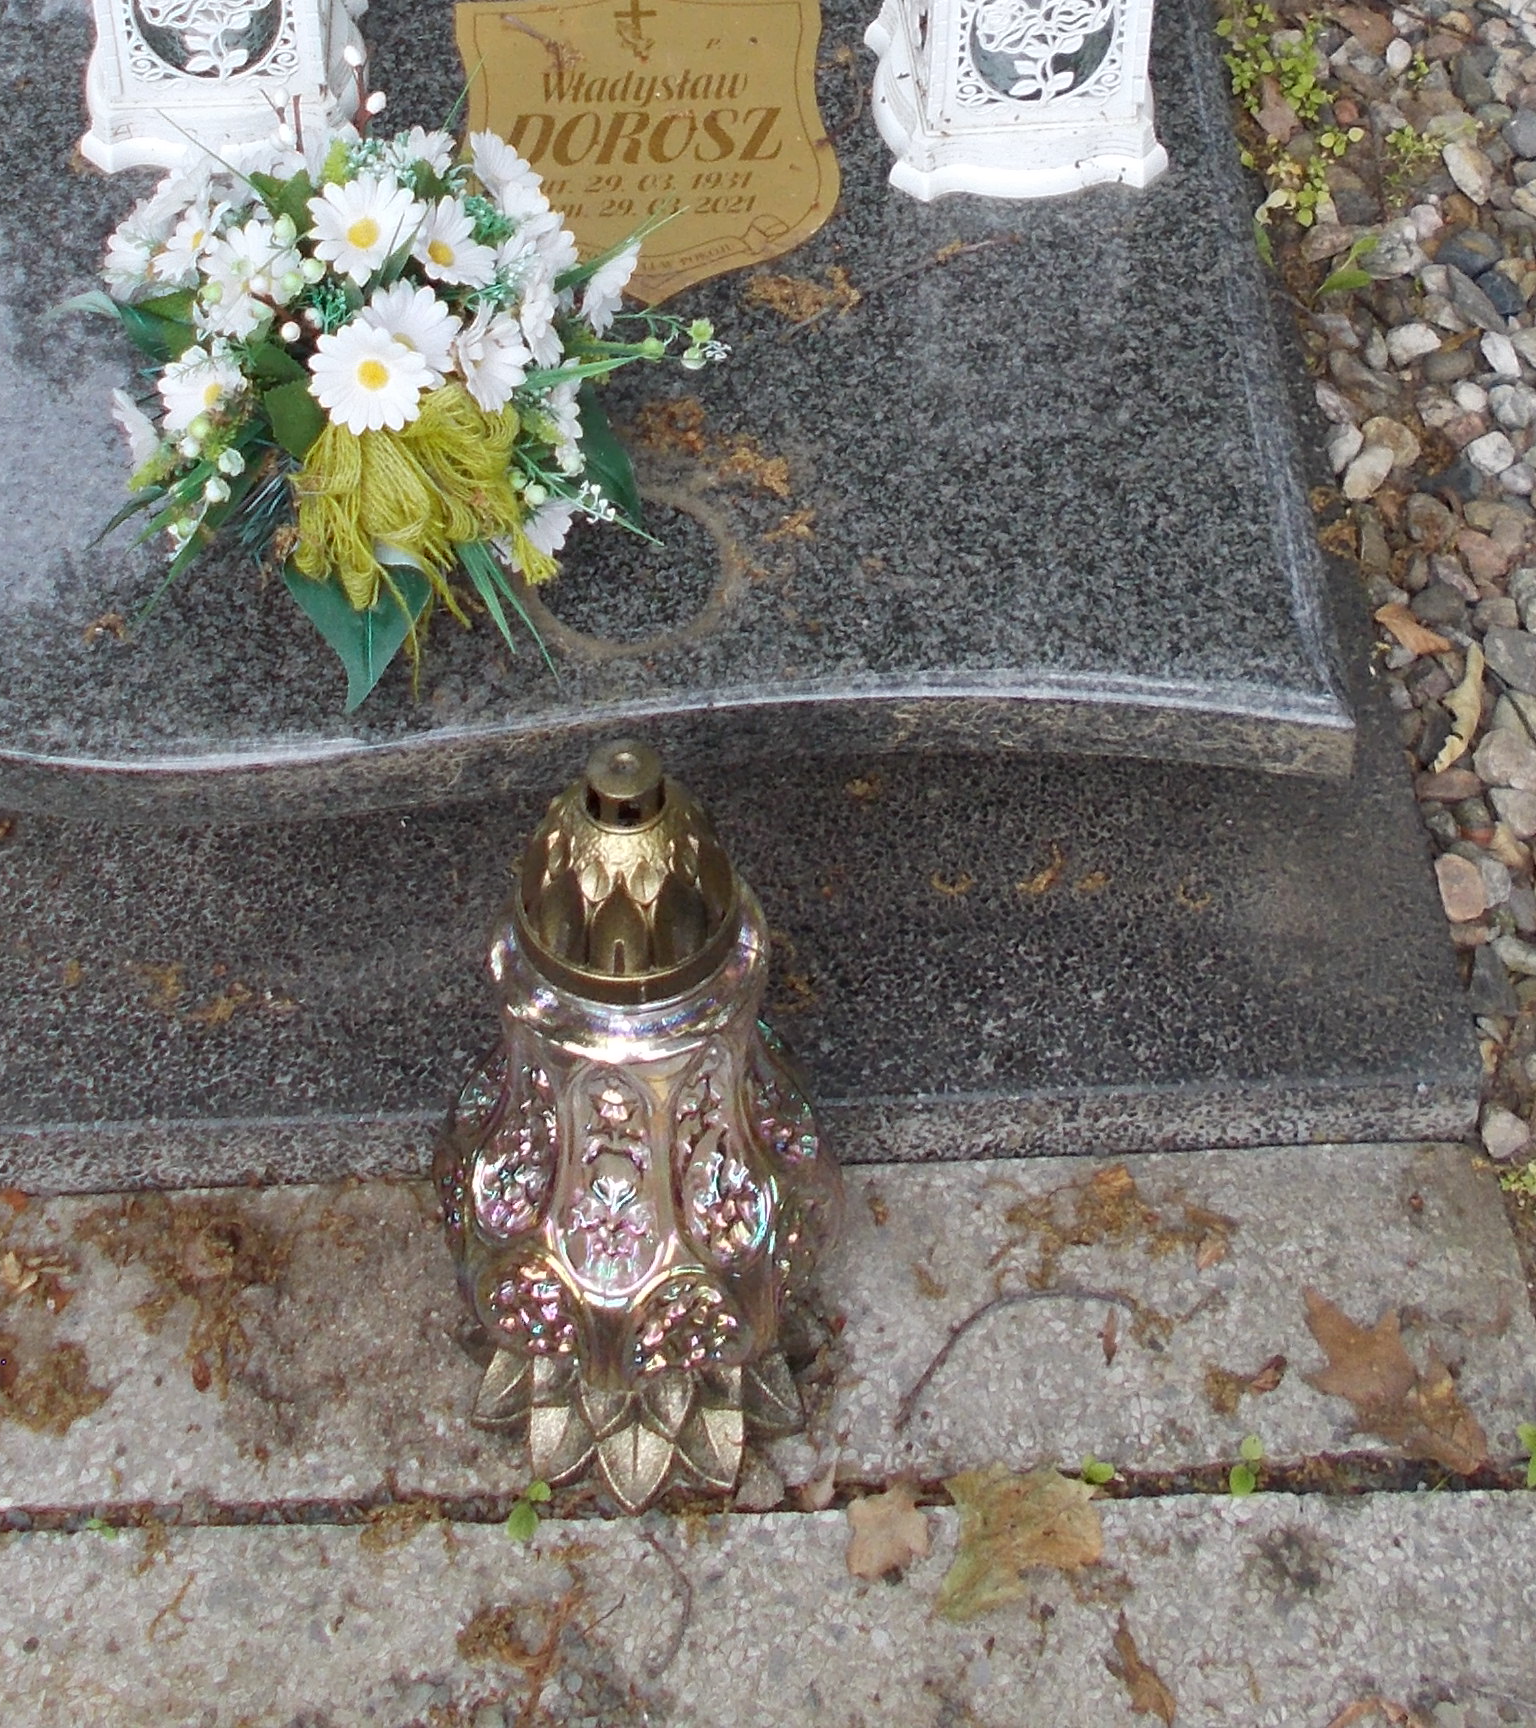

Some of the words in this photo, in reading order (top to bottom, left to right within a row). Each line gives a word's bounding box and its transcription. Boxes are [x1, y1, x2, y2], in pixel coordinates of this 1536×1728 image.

[543, 69, 749, 108] Władysław
[507, 106, 783, 167] DOROSZ
[694, 194, 757, 215] 2021
